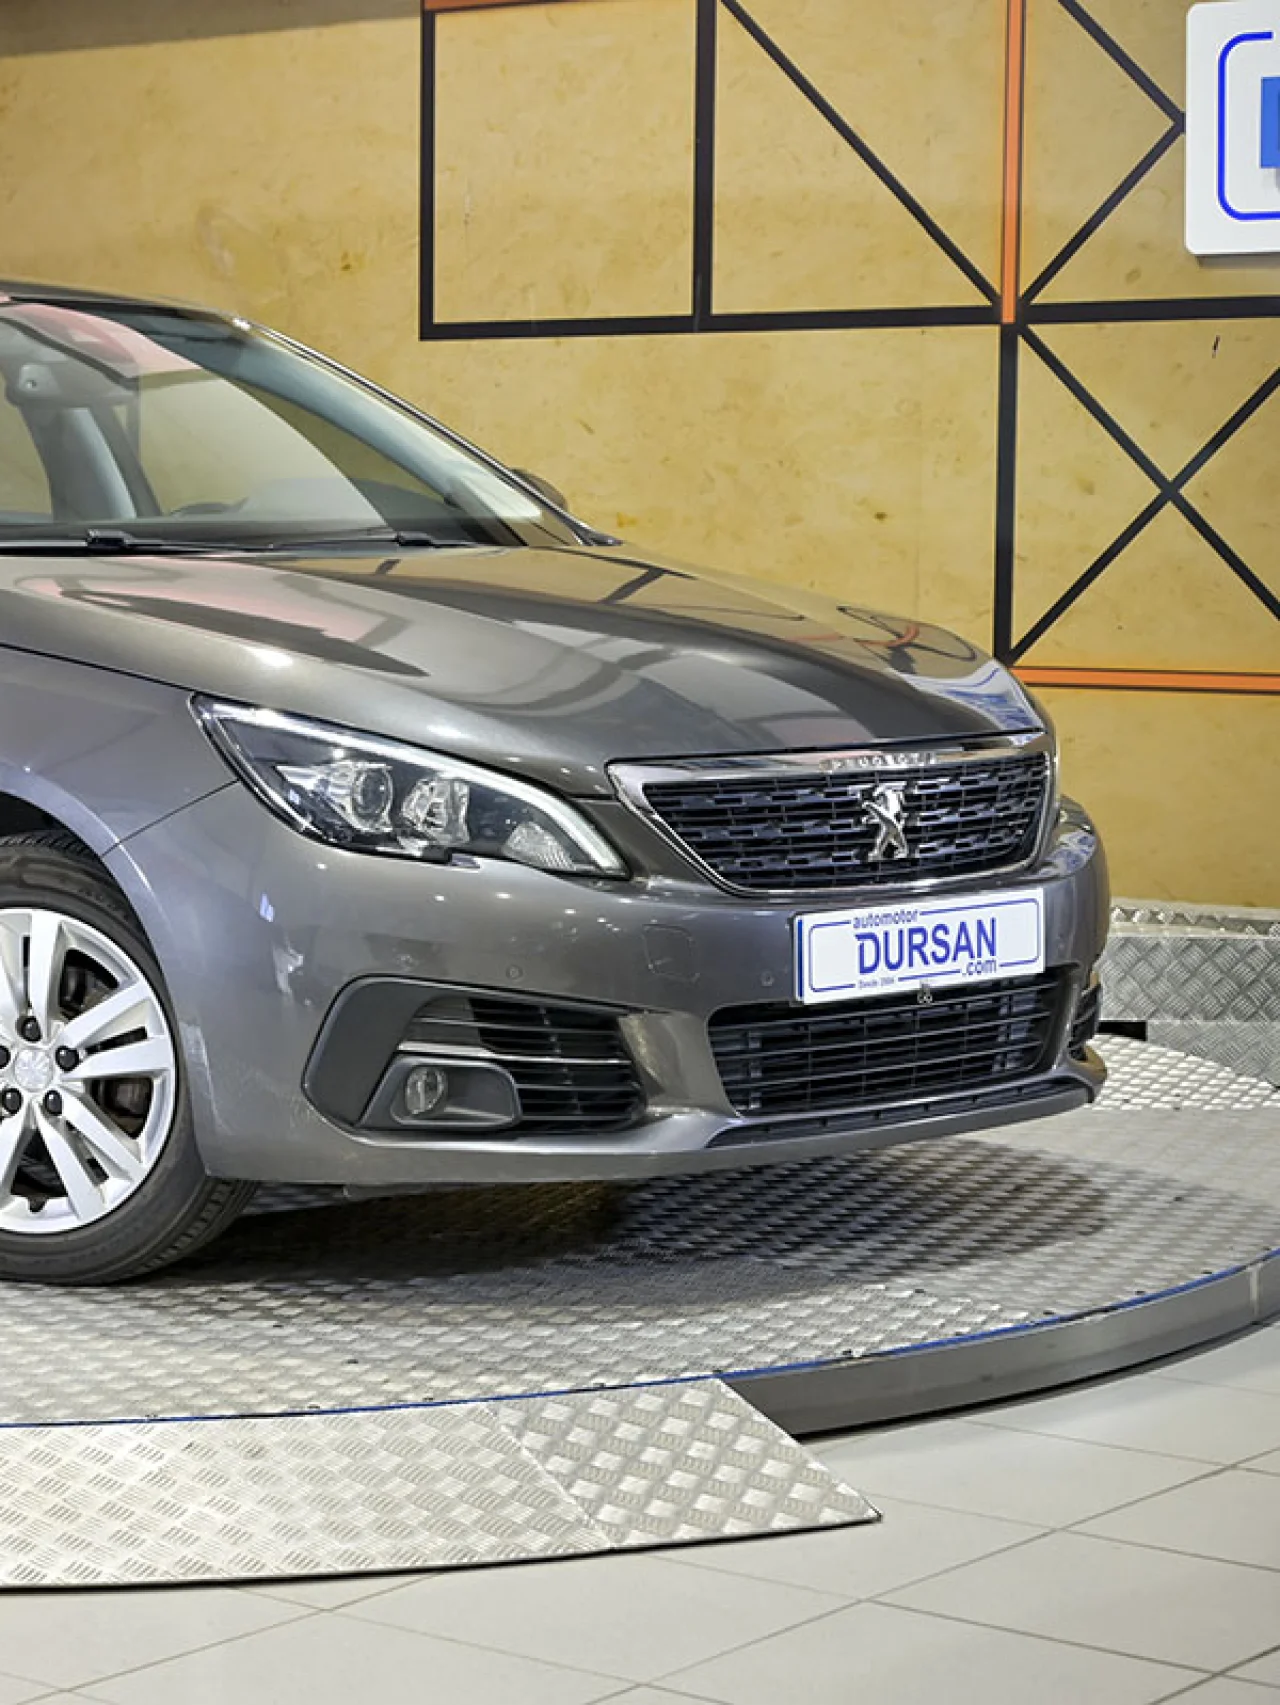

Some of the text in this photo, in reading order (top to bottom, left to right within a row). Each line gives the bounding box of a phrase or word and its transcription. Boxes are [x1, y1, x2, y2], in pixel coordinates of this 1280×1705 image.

[853, 909, 919, 929] automotor
[855, 917, 996, 974] DURSAN
[962, 958, 997, 976] .com
